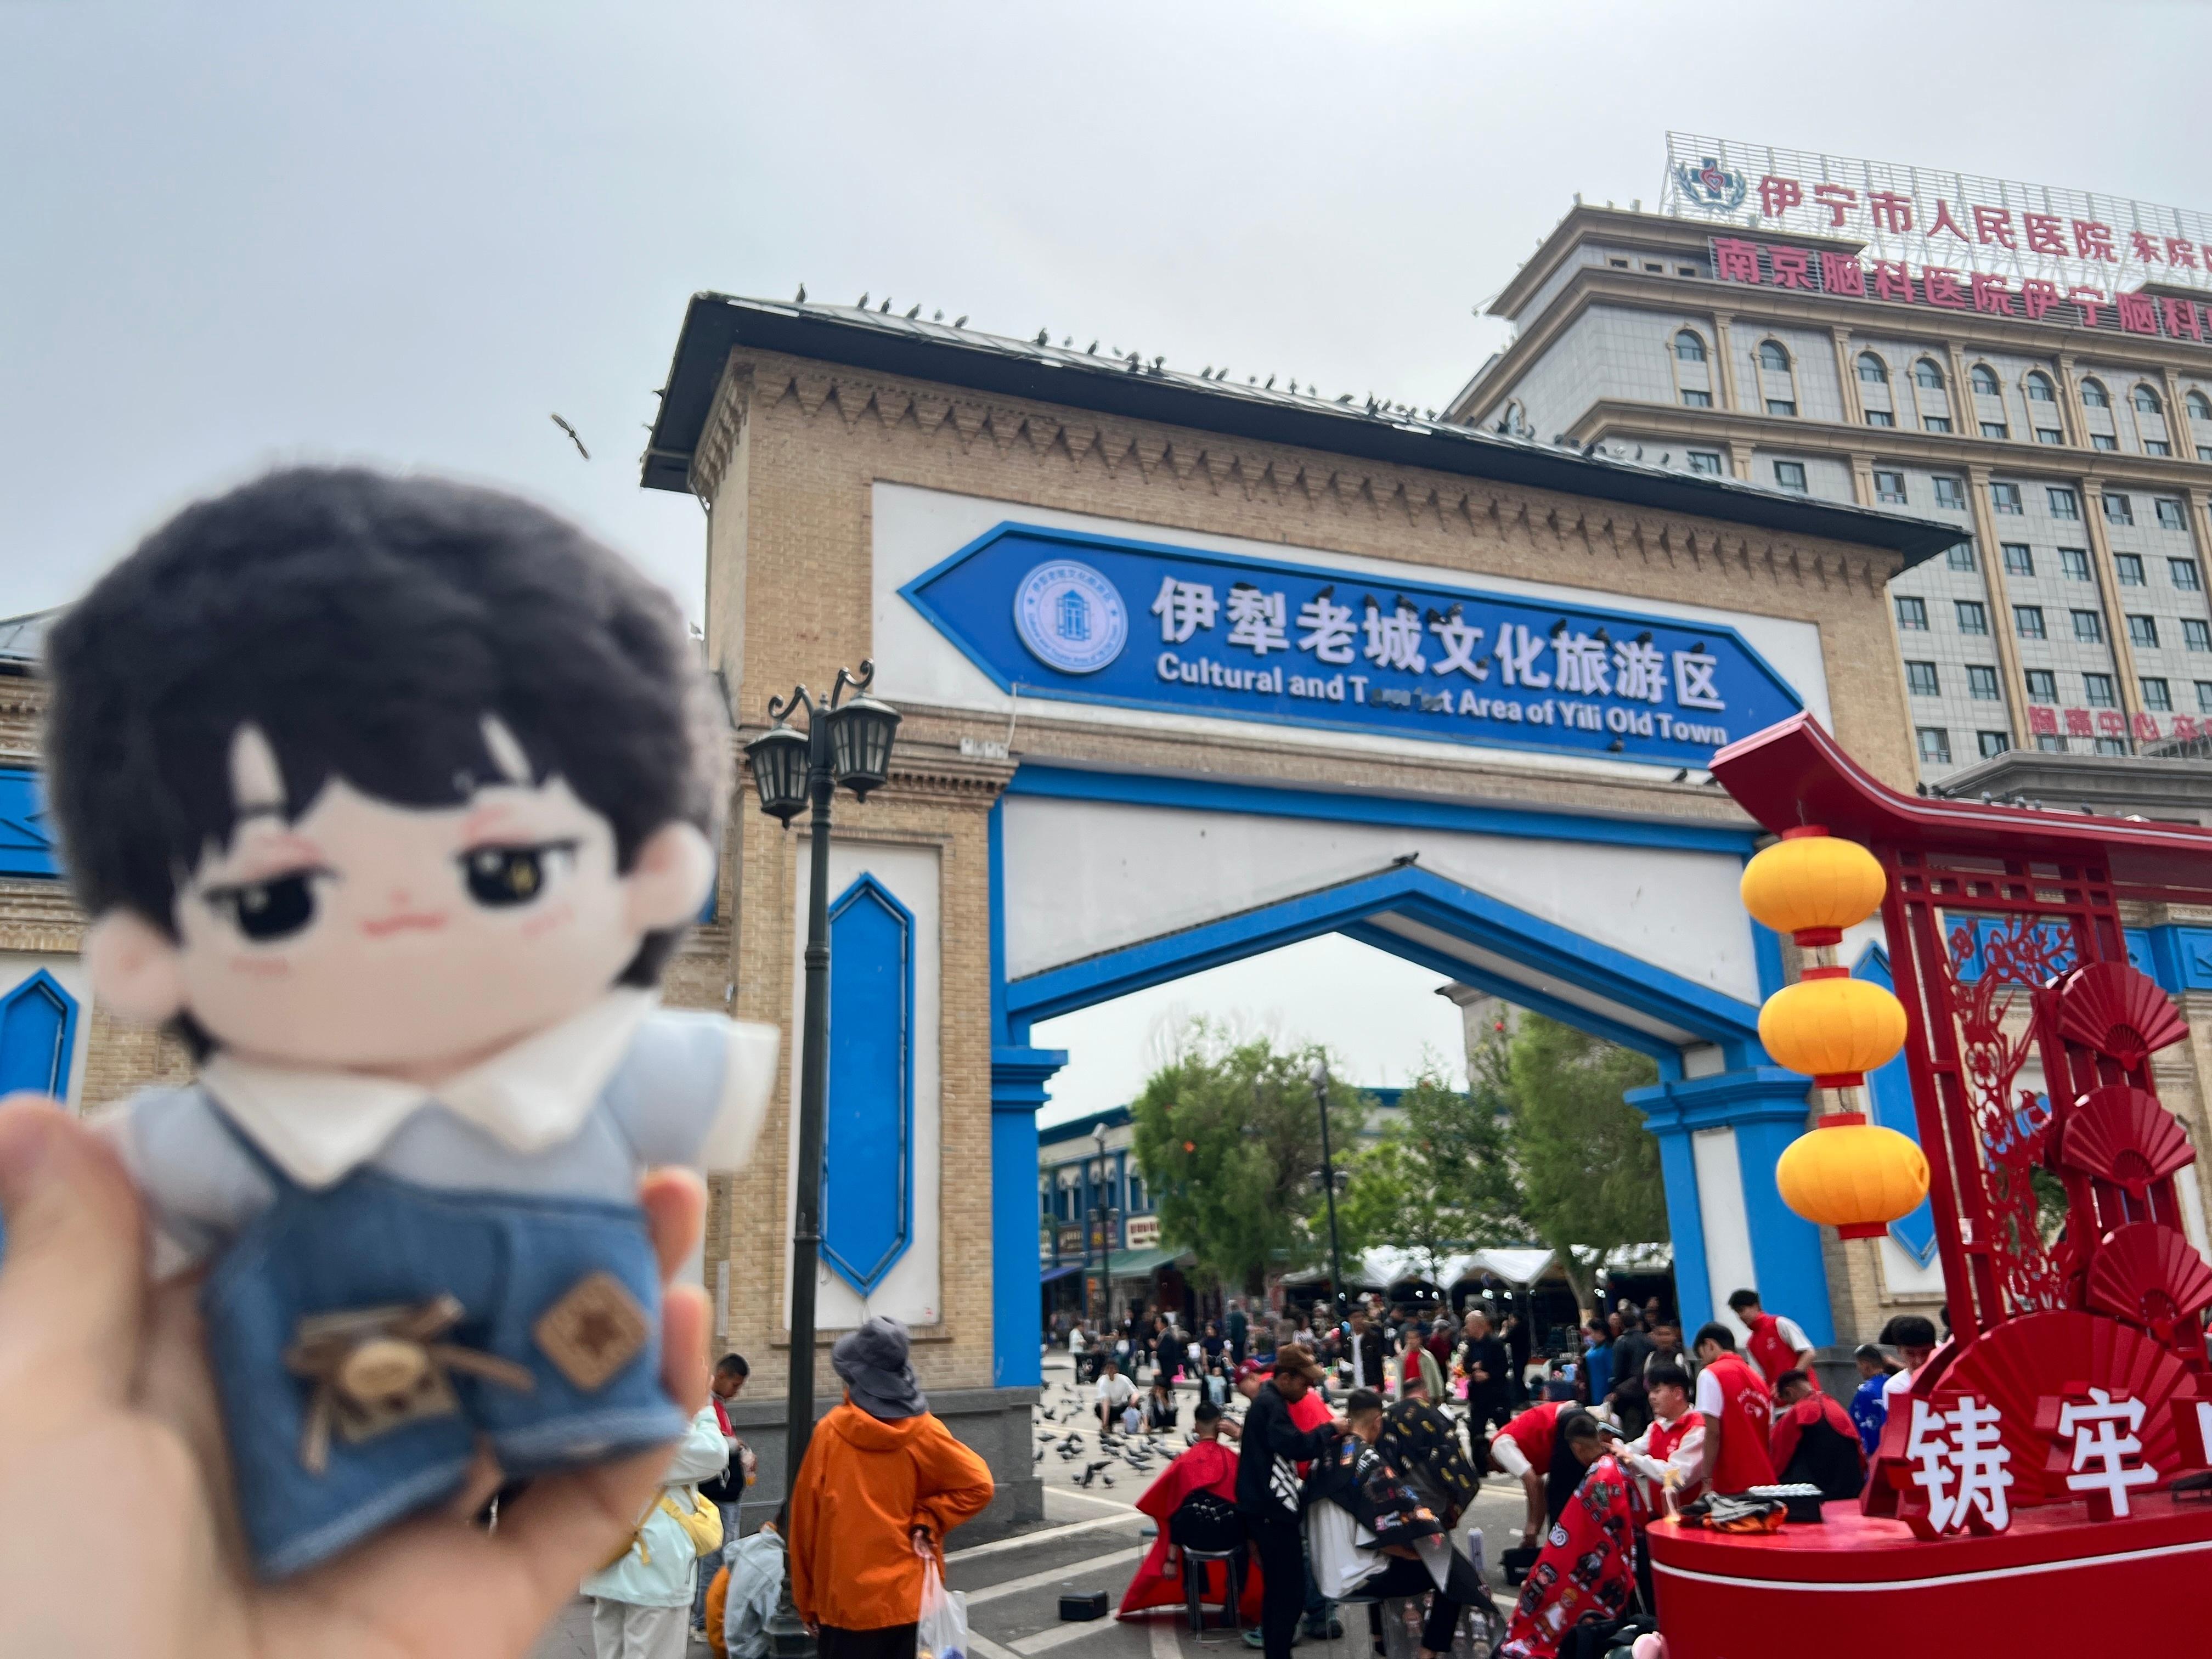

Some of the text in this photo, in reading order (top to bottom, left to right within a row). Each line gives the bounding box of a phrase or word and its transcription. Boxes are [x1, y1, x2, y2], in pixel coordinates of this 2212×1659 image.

[1713, 237, 2212, 342] 南京脑科医院伊宁脑科
[1152, 576, 1726, 710] 伊犁老城文化旅游区
[1157, 652, 1283, 693] Cultural
[1288, 673, 1345, 702] and
[1459, 689, 1523, 722] Area
[1525, 699, 1554, 726] of
[1556, 701, 1602, 731] Yili
[1605, 707, 1654, 737] Old
[1655, 713, 1728, 746] Town
[1906, 1387, 2212, 1533] 铸牢
